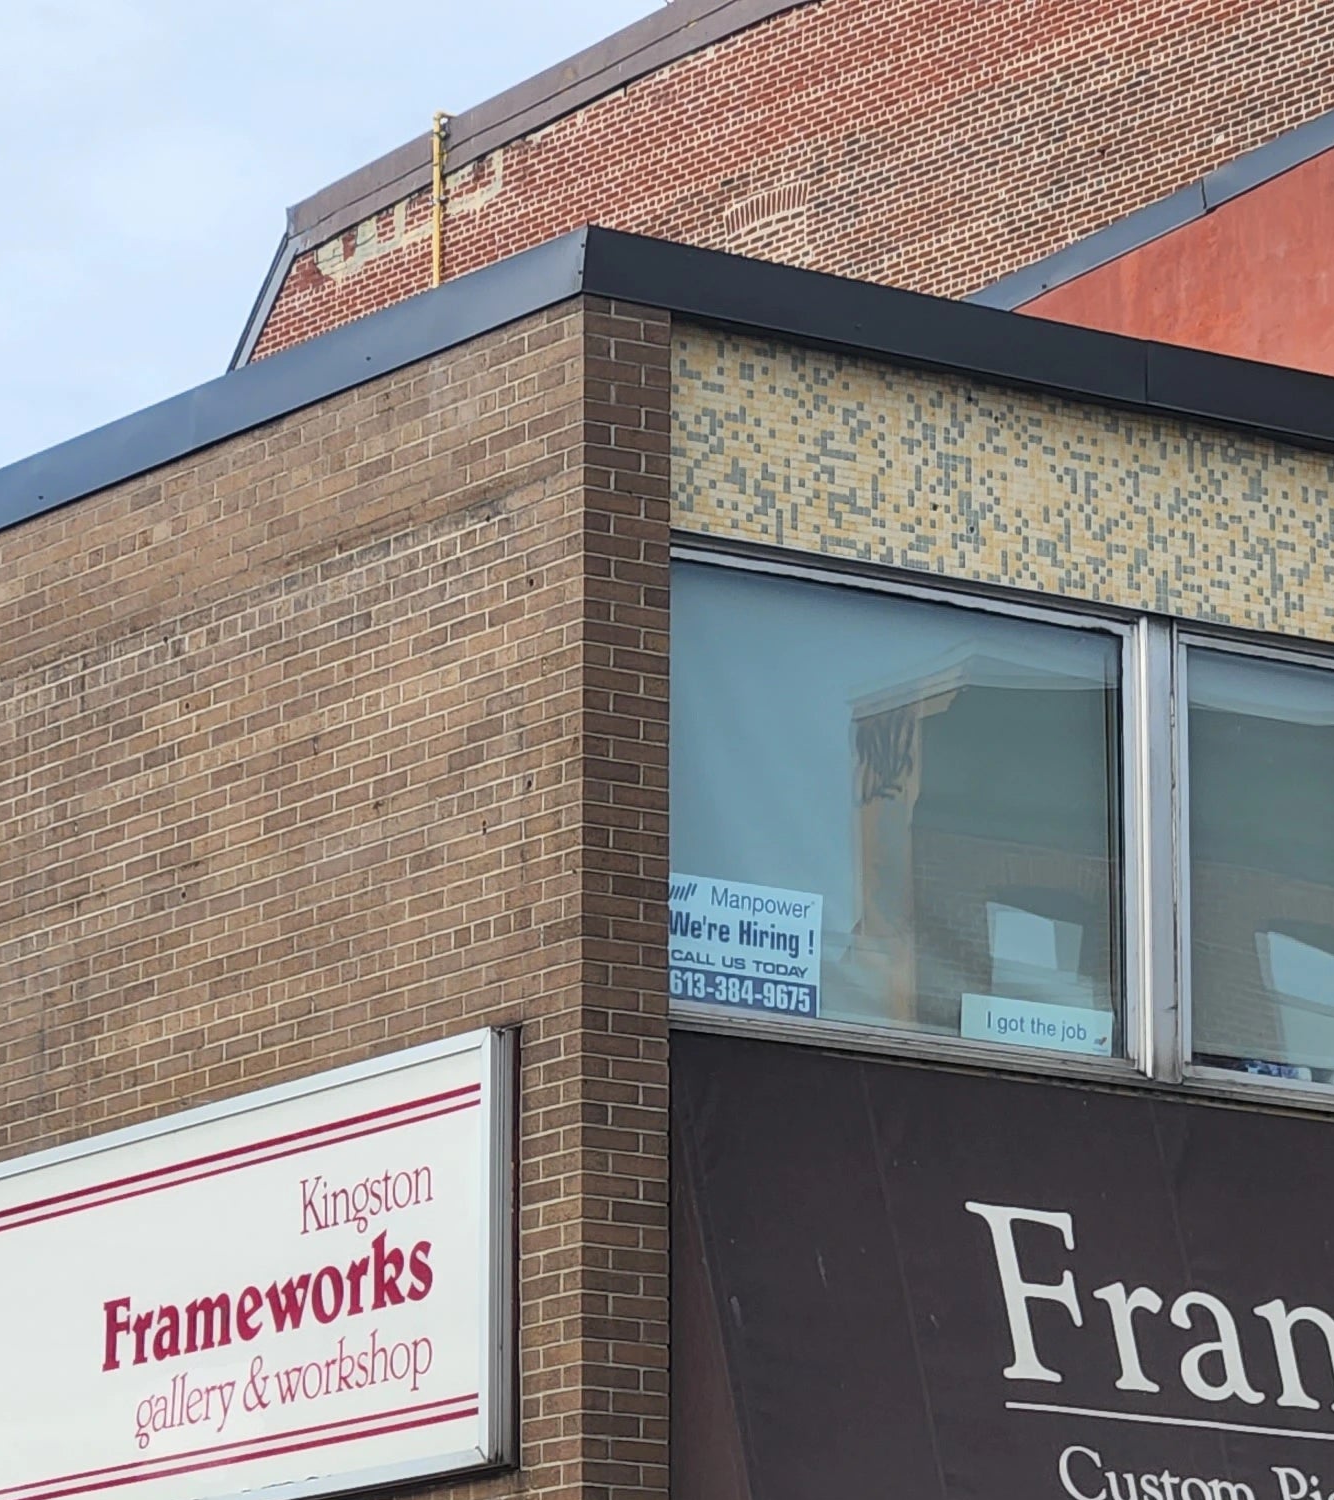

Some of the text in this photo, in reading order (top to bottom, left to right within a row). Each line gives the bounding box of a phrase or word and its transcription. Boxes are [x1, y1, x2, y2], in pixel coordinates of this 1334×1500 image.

[711, 886, 810, 919] Manpower
[669, 910, 730, 943] We're
[739, 920, 799, 959] Hiring
[671, 949, 808, 978] CALL US TODAY
[669, 969, 810, 1013] 613-384-9675
[987, 1010, 1087, 1042] I got the job
[300, 1166, 434, 1234] Kingston
[102, 1229, 433, 1372] Frameworks
[135, 1329, 433, 1449] gallery & workshop
